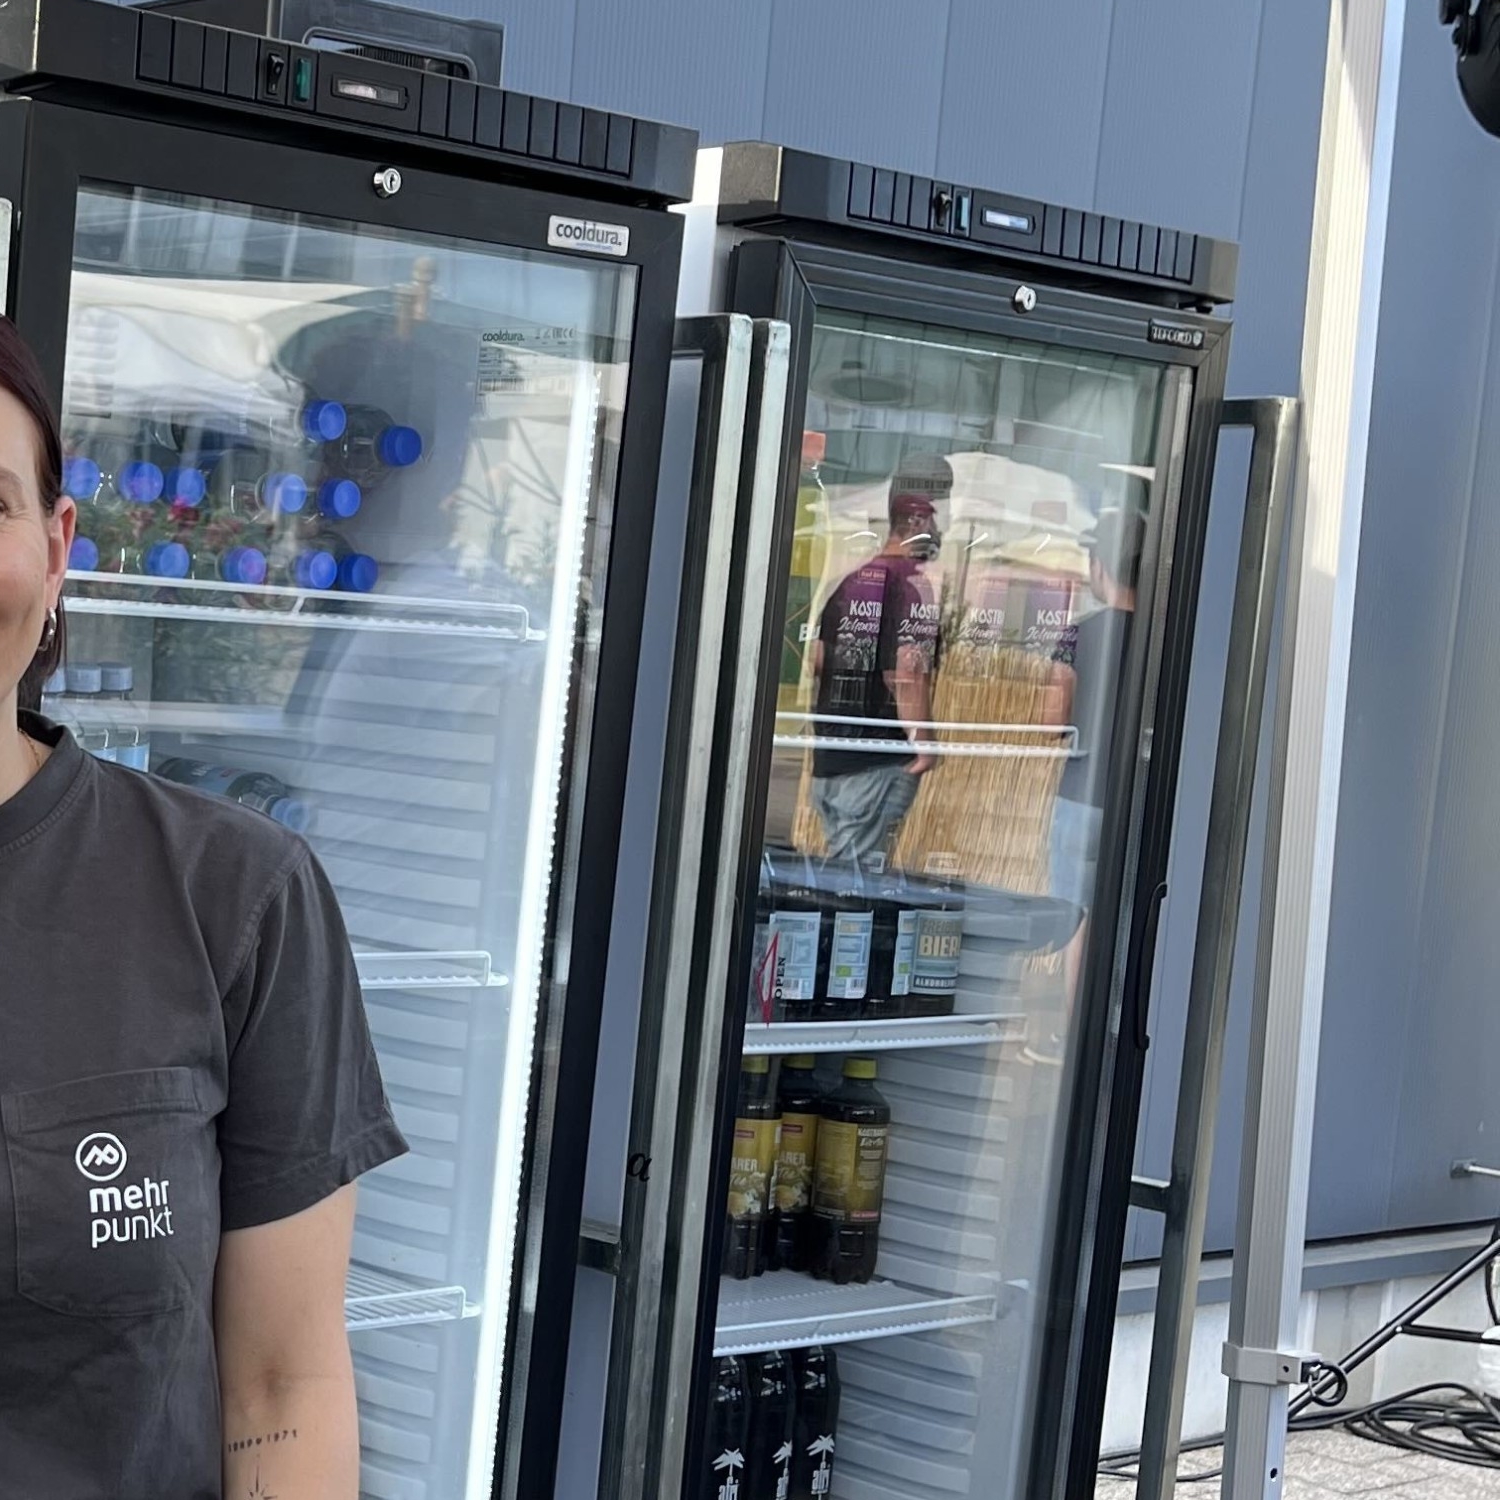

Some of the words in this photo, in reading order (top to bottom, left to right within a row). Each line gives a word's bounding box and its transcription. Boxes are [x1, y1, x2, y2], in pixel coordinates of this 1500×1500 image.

[556, 221, 622, 246] cooldura.
[919, 935, 958, 957] BIER
[775, 957, 786, 999] OPEN
[89, 1177, 170, 1213] mehr
[91, 1206, 174, 1249] punkt
